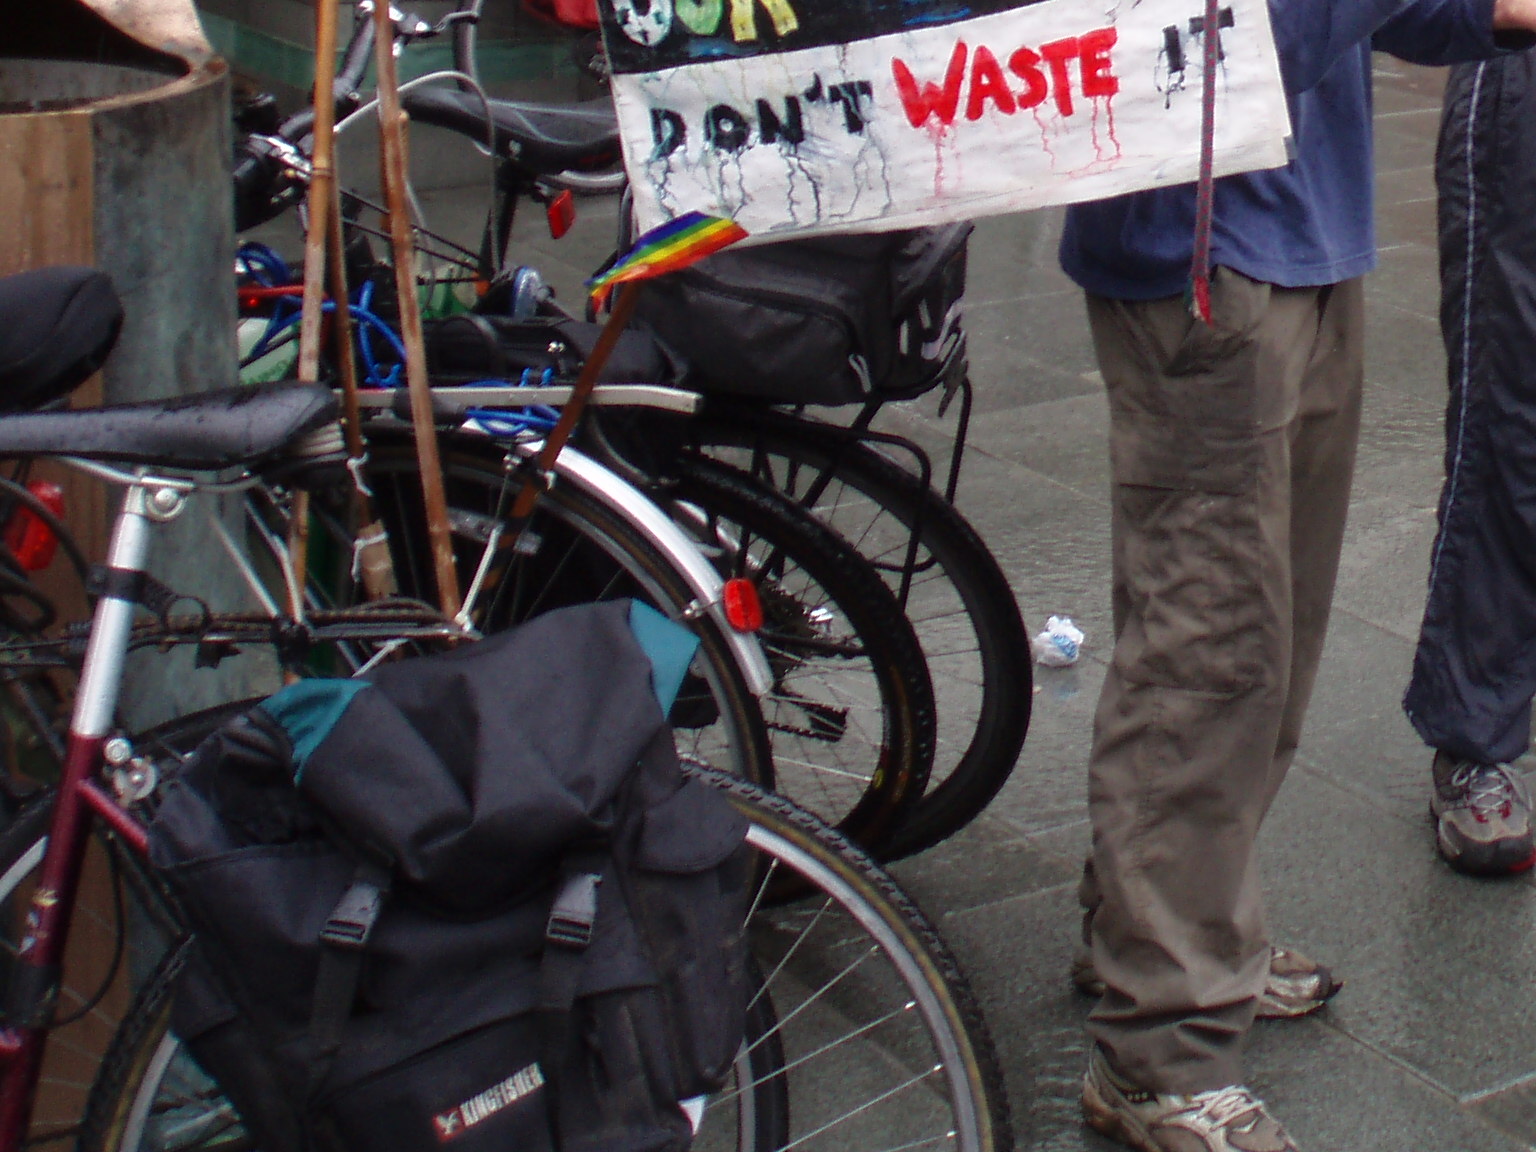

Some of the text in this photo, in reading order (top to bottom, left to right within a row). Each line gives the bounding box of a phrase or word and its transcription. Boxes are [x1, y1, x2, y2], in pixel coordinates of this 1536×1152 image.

[650, 7, 1235, 160] DON'T WASTE IT
[460, 1061, 544, 1127] KINGFISHER
